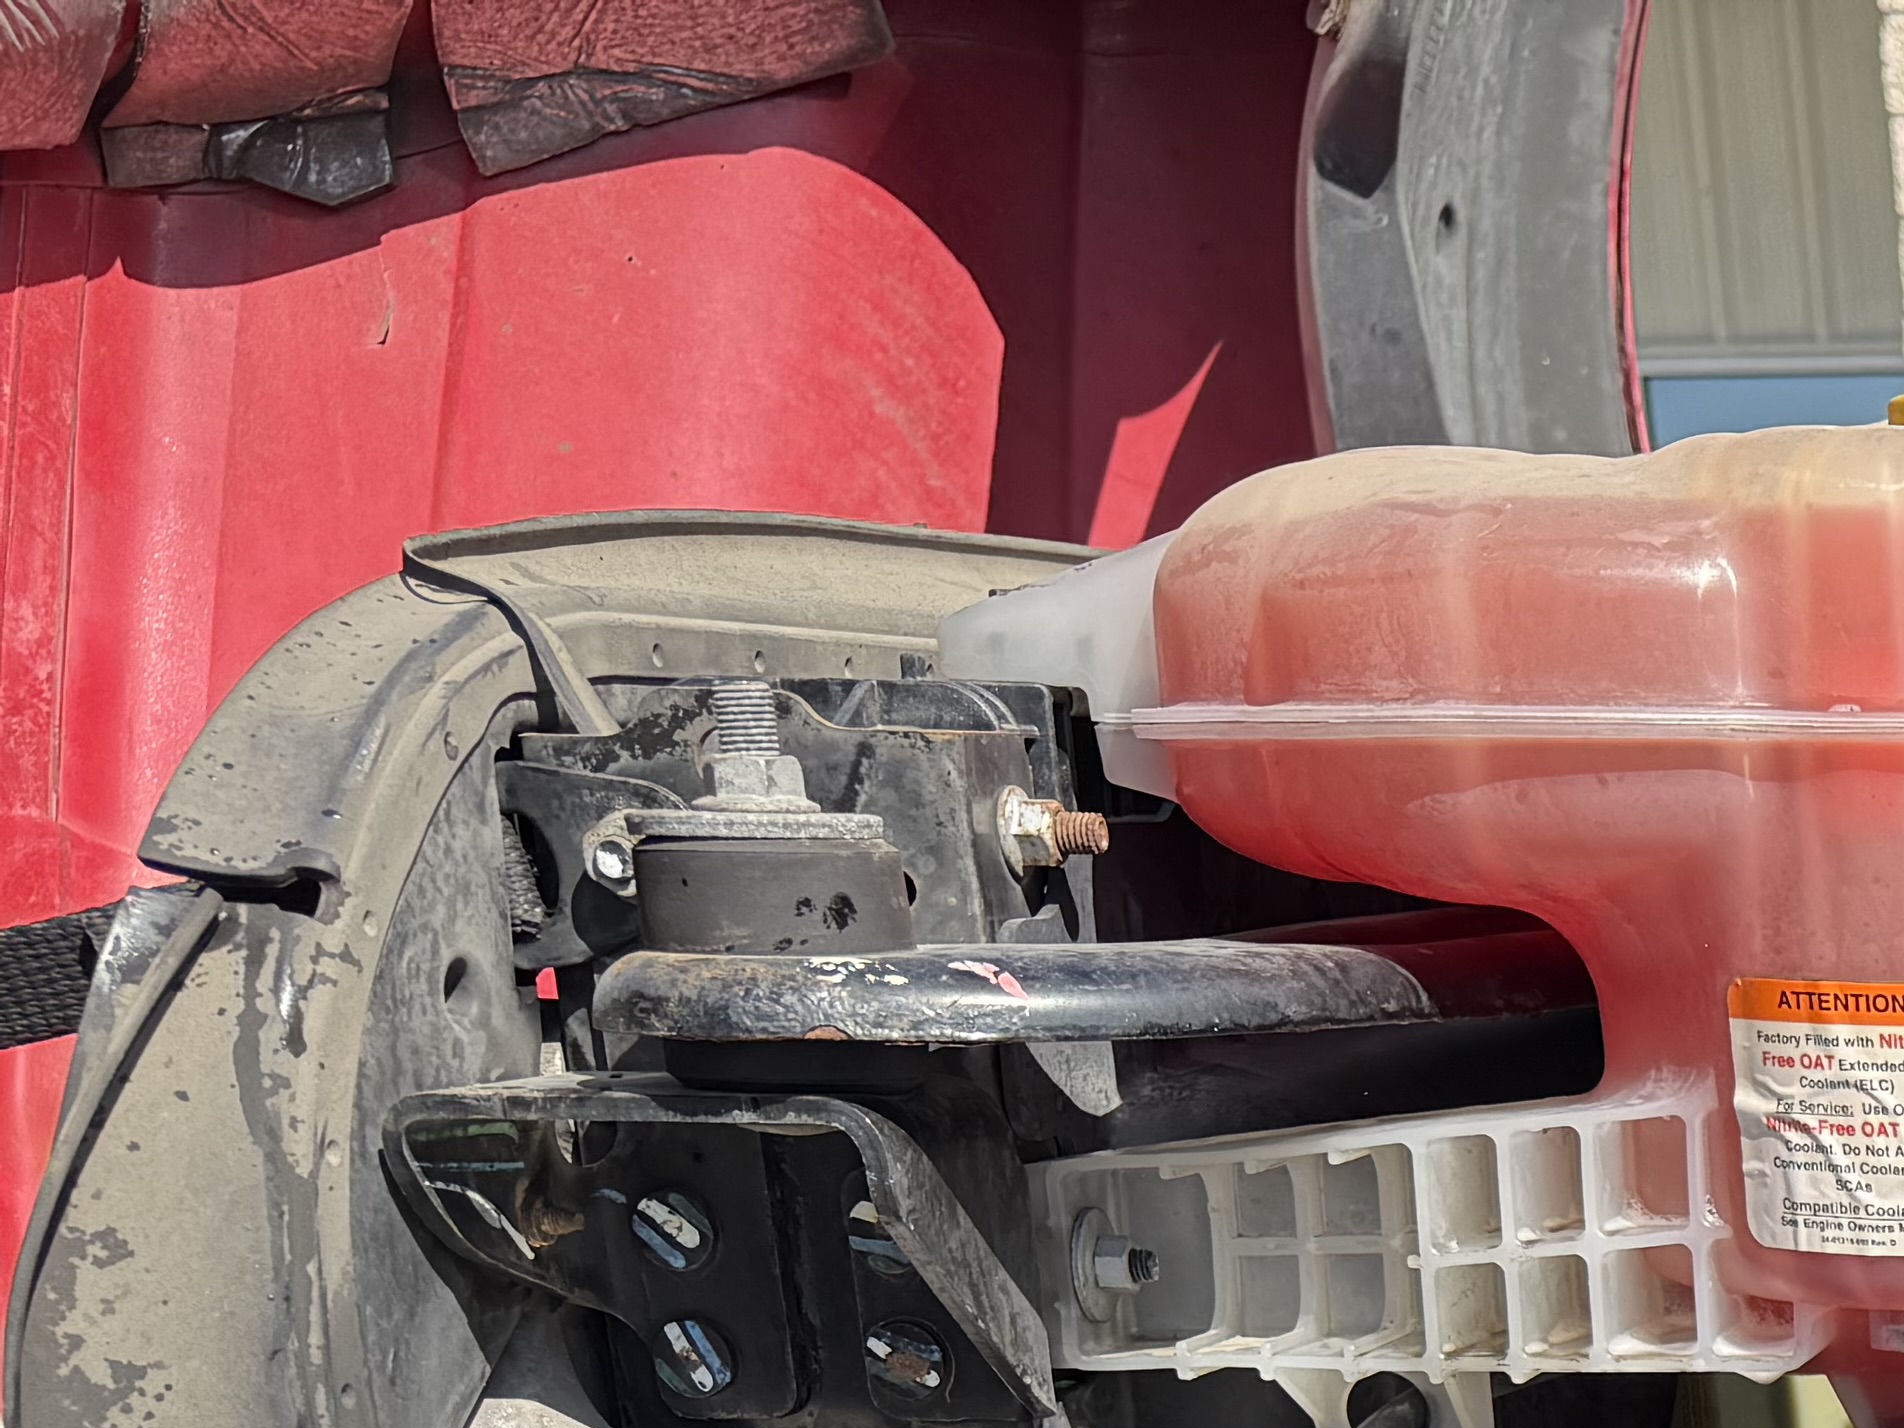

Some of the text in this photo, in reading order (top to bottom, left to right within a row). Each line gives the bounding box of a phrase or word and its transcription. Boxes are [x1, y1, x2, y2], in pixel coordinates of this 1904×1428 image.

[1757, 1030, 1801, 1048] Factory
[1805, 1034, 1839, 1048] Filled
[1844, 1035, 1874, 1049] with
[1762, 1052, 1795, 1068] Free
[1800, 1053, 1835, 1071] OAT
[1799, 1077, 1895, 1094] Coolant (ELC)
[1776, 1099, 1794, 1112] For
[1862, 1103, 1889, 1115] Use
[1765, 1116, 1856, 1137] Nitrite-Free
[1861, 1121, 1899, 1138] OAT
[1785, 1140, 1837, 1156] Coolant.
[1843, 1143, 1861, 1156] Do
[1866, 1145, 1890, 1157] Not
[1774, 1157, 1856, 1175] Conventional
[1835, 1179, 1873, 1193] SCAs
[1783, 1198, 1860, 1217] Compatible
[1781, 1216, 1798, 1229] See
[1803, 1217, 1843, 1232] Engine
[1848, 1221, 1894, 1233] Owners
